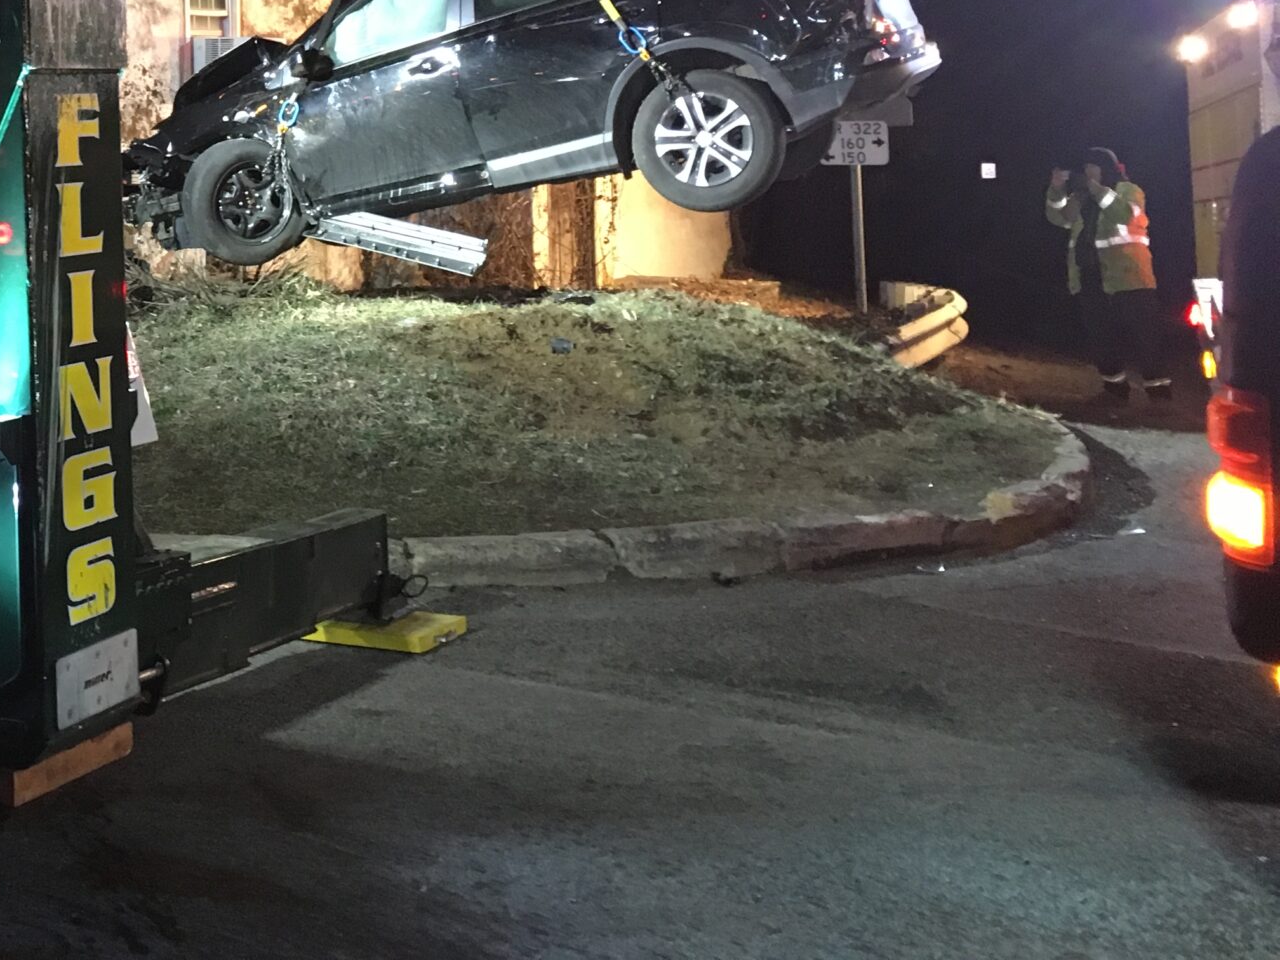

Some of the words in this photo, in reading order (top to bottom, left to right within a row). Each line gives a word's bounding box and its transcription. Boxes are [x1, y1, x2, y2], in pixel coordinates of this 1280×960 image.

[851, 122, 882, 135] 322
[840, 137, 865, 150] 160
[841, 151, 866, 164] 150
[55, 92, 119, 627] FLINGS
